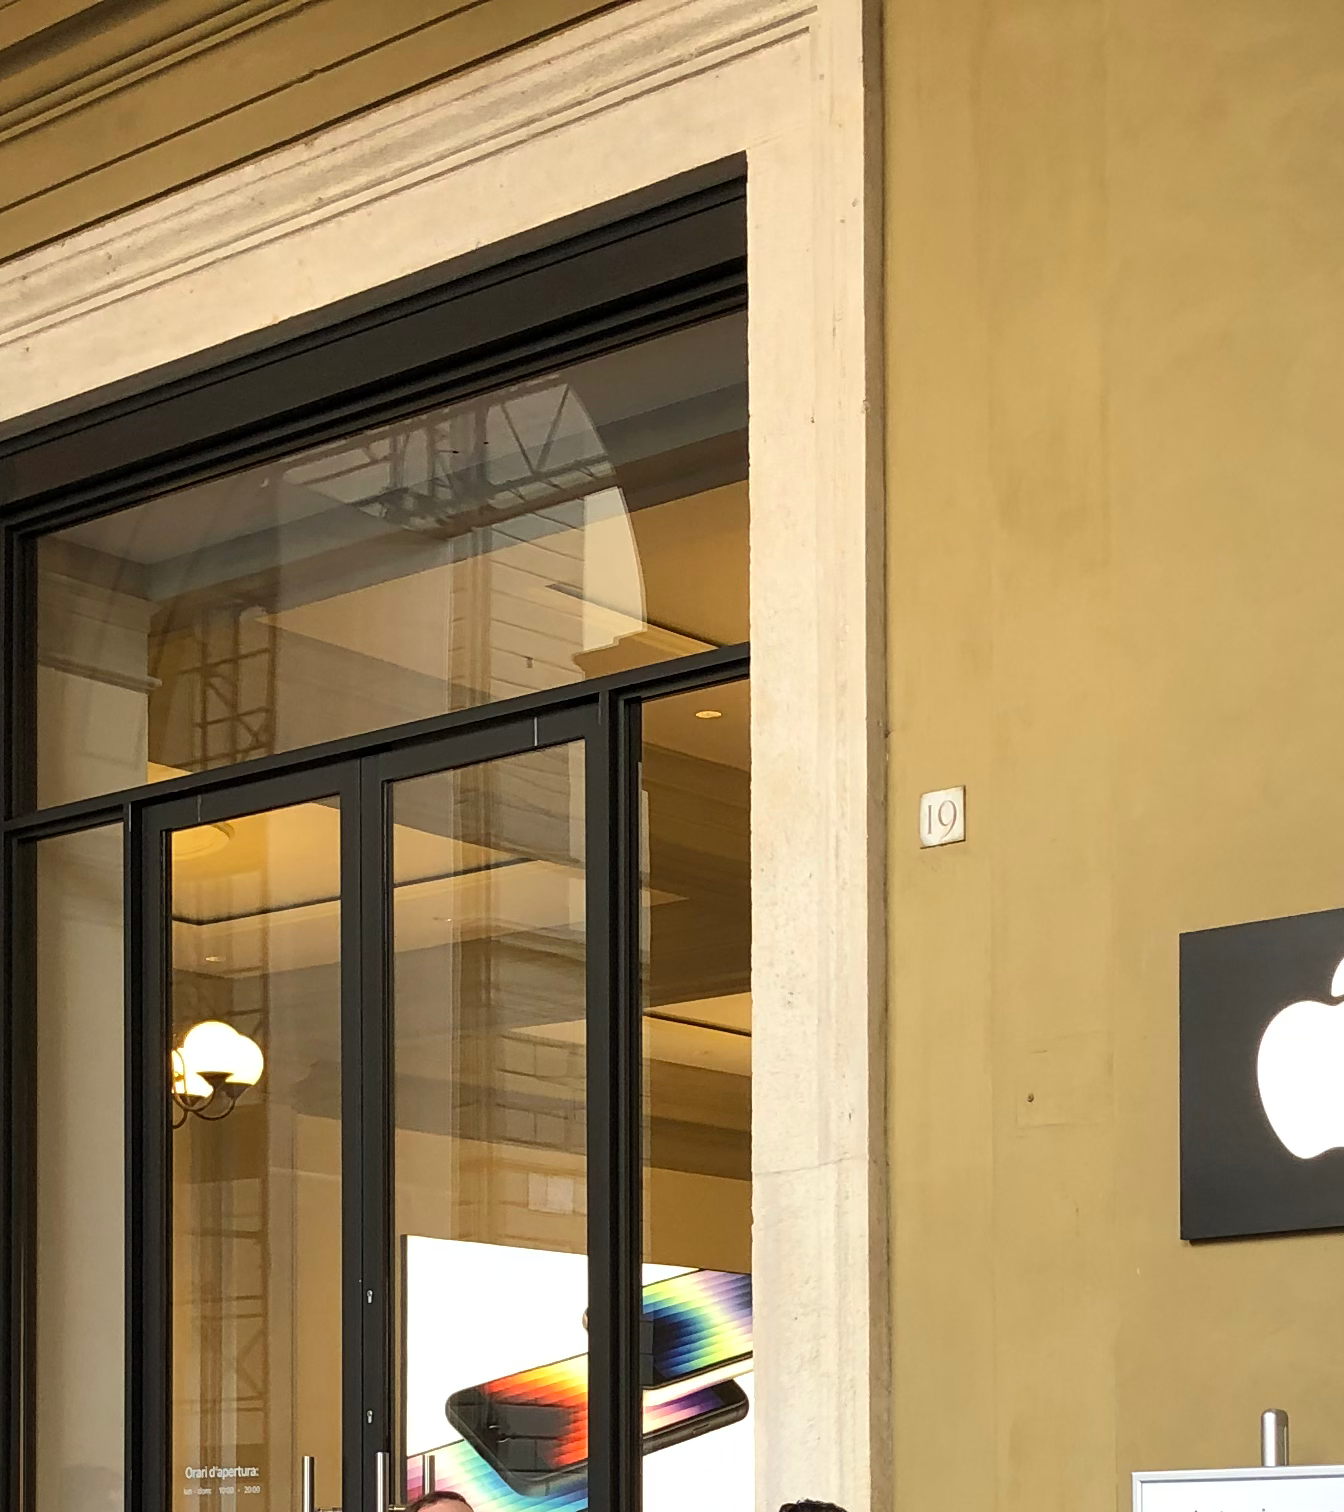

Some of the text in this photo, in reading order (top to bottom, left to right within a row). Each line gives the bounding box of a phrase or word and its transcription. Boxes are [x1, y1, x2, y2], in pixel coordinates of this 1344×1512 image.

[927, 799, 958, 840] 19
[185, 1465, 260, 1480] Orari d'apertura:
